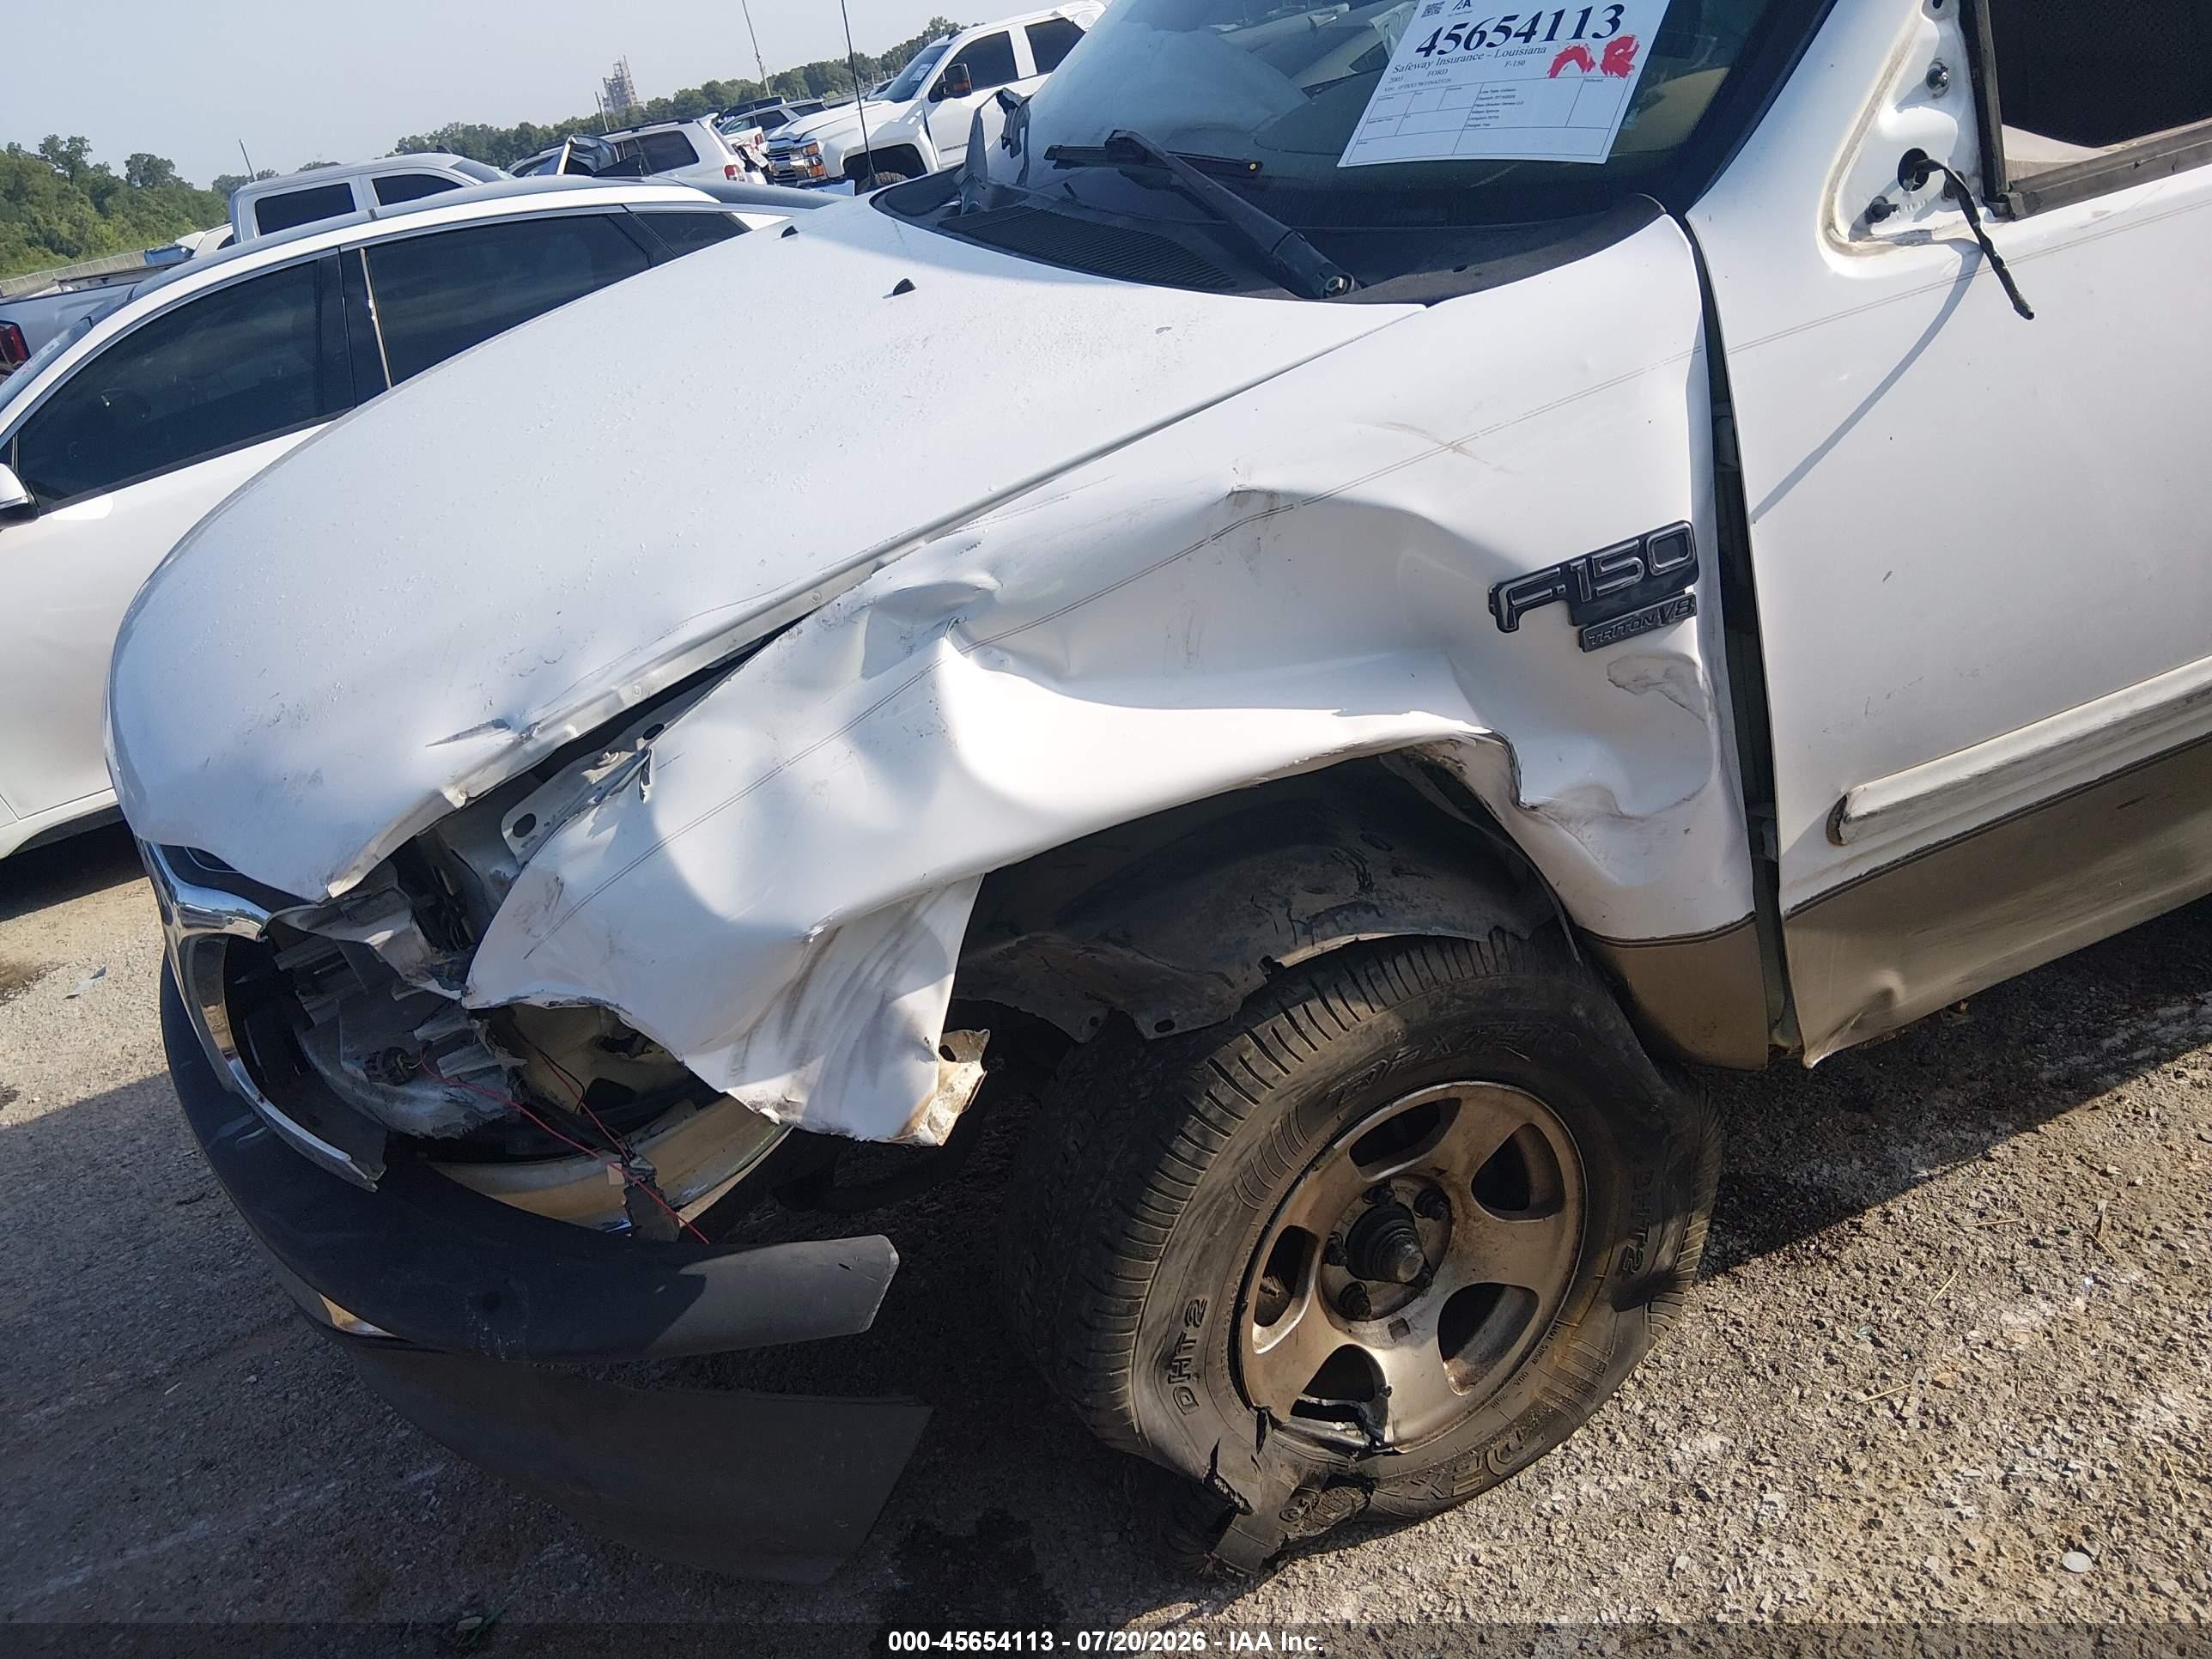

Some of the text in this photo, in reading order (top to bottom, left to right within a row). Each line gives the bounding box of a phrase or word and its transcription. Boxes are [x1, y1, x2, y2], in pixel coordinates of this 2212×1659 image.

[1415, 3, 1625, 58] 45654113
[1393, 60, 1433, 74] Safeway
[1436, 52, 1484, 67] Insurance
[1494, 46, 1547, 59] Louisiana
[1426, 68, 1449, 77] FORD
[1498, 522, 1696, 630] F-150
[1588, 599, 1695, 646] TRITON V8
[1167, 1297, 1208, 1417] DHT2
